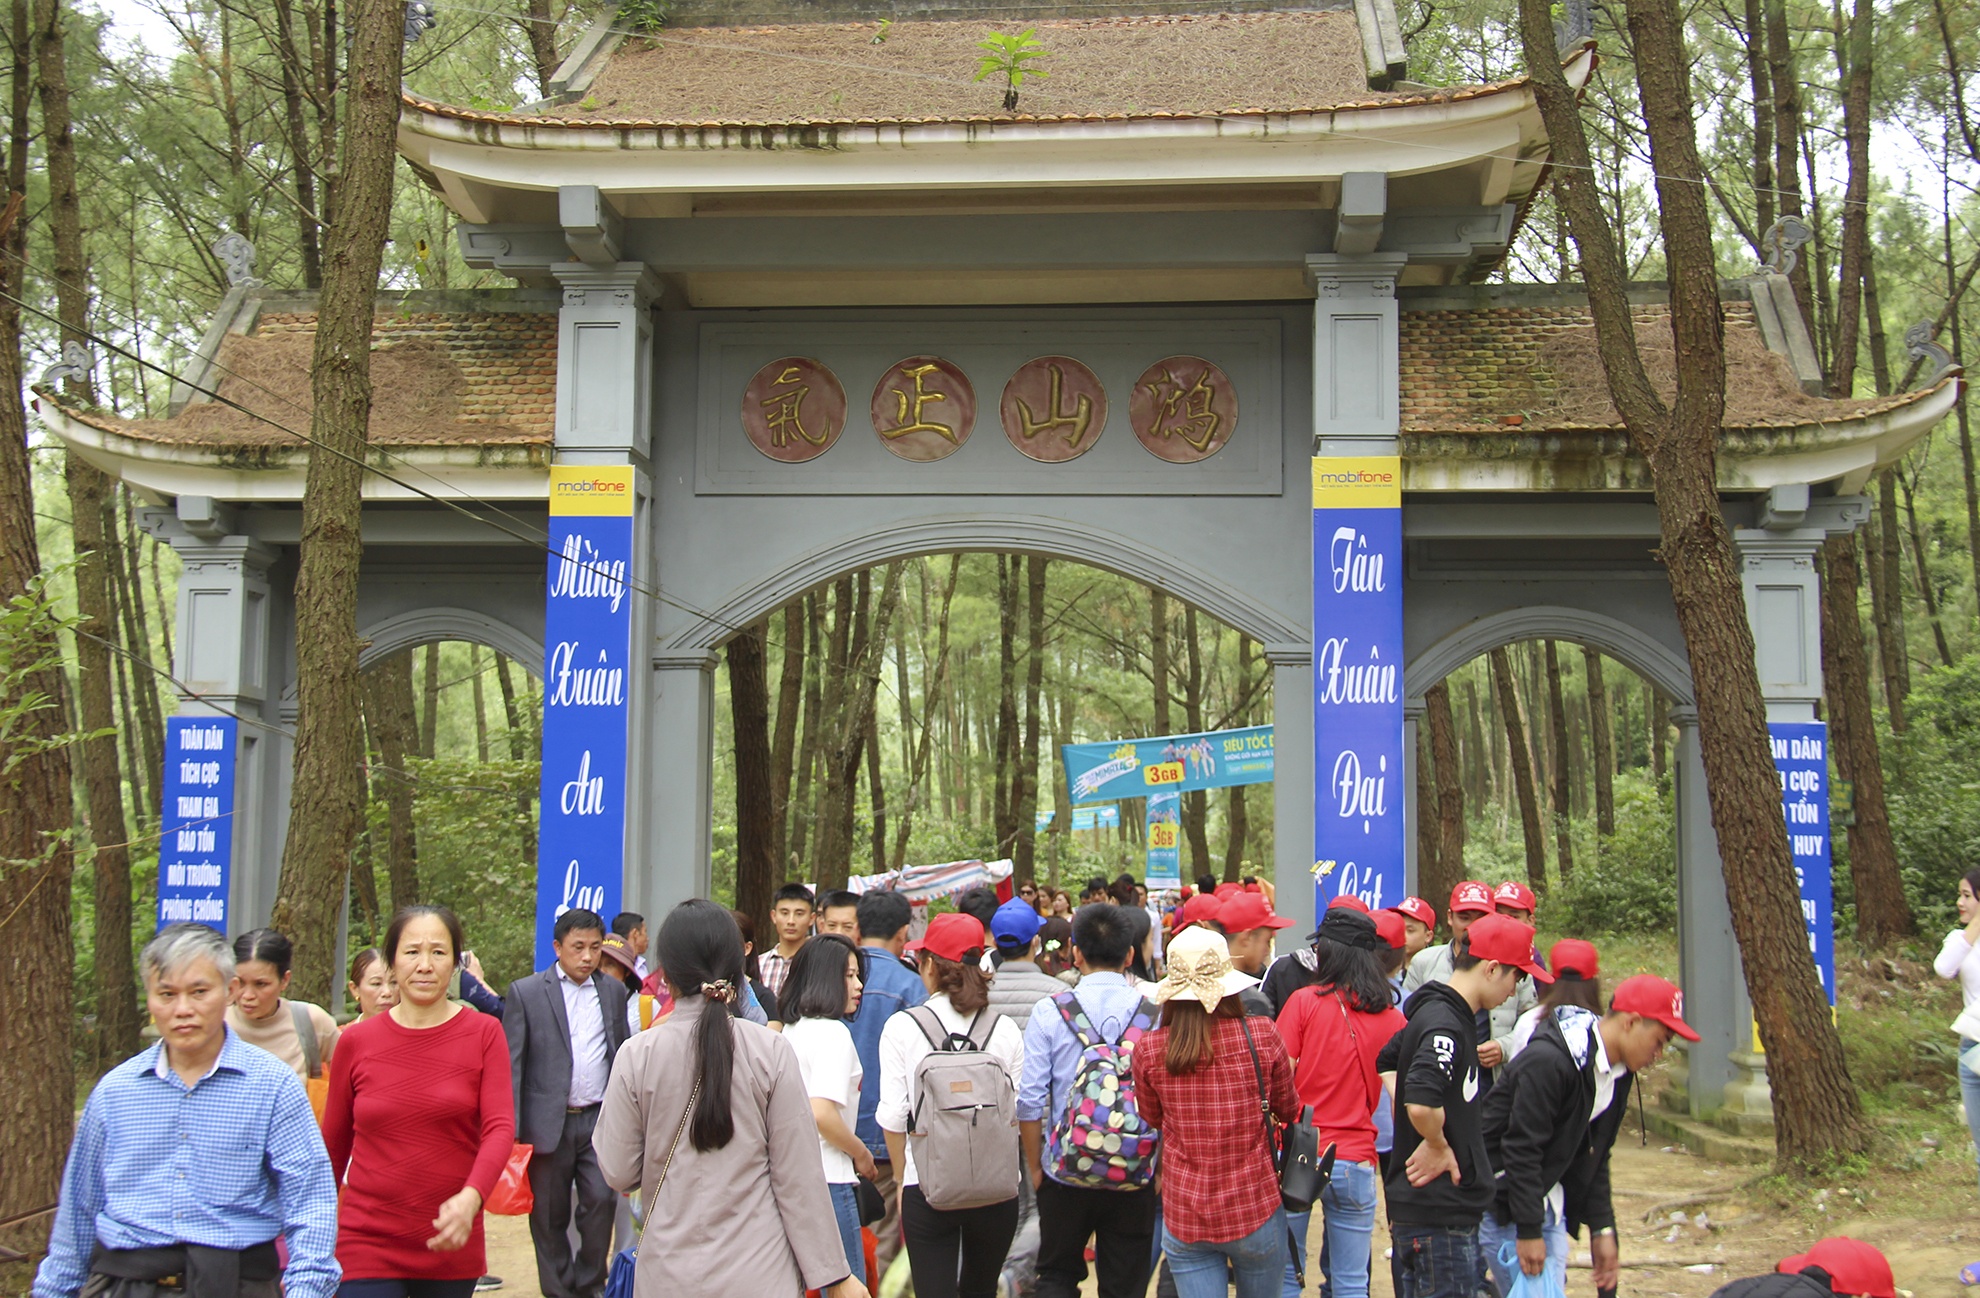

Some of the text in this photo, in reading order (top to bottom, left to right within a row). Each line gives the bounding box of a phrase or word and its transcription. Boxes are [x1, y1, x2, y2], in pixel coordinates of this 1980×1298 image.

[558, 479, 625, 492] mobifone
[1321, 470, 1392, 483] mobifone
[551, 533, 626, 614] Mừng
[1331, 527, 1386, 594] Tân
[551, 641, 624, 707] Xuân
[1320, 637, 1398, 705] Xuân
[1791, 735, 1822, 760] DÂN
[180, 758, 220, 789] TÍCH CỰC
[561, 750, 605, 816] An
[1789, 769, 1819, 796] CỰC
[1332, 750, 1387, 835] Đại
[177, 796, 219, 818] THAM GIA
[1789, 796, 1819, 824] TỒN
[1153, 825, 1174, 846] 3GB
[1794, 835, 1823, 856] HUY
[1800, 899, 1816, 925] RỊ
